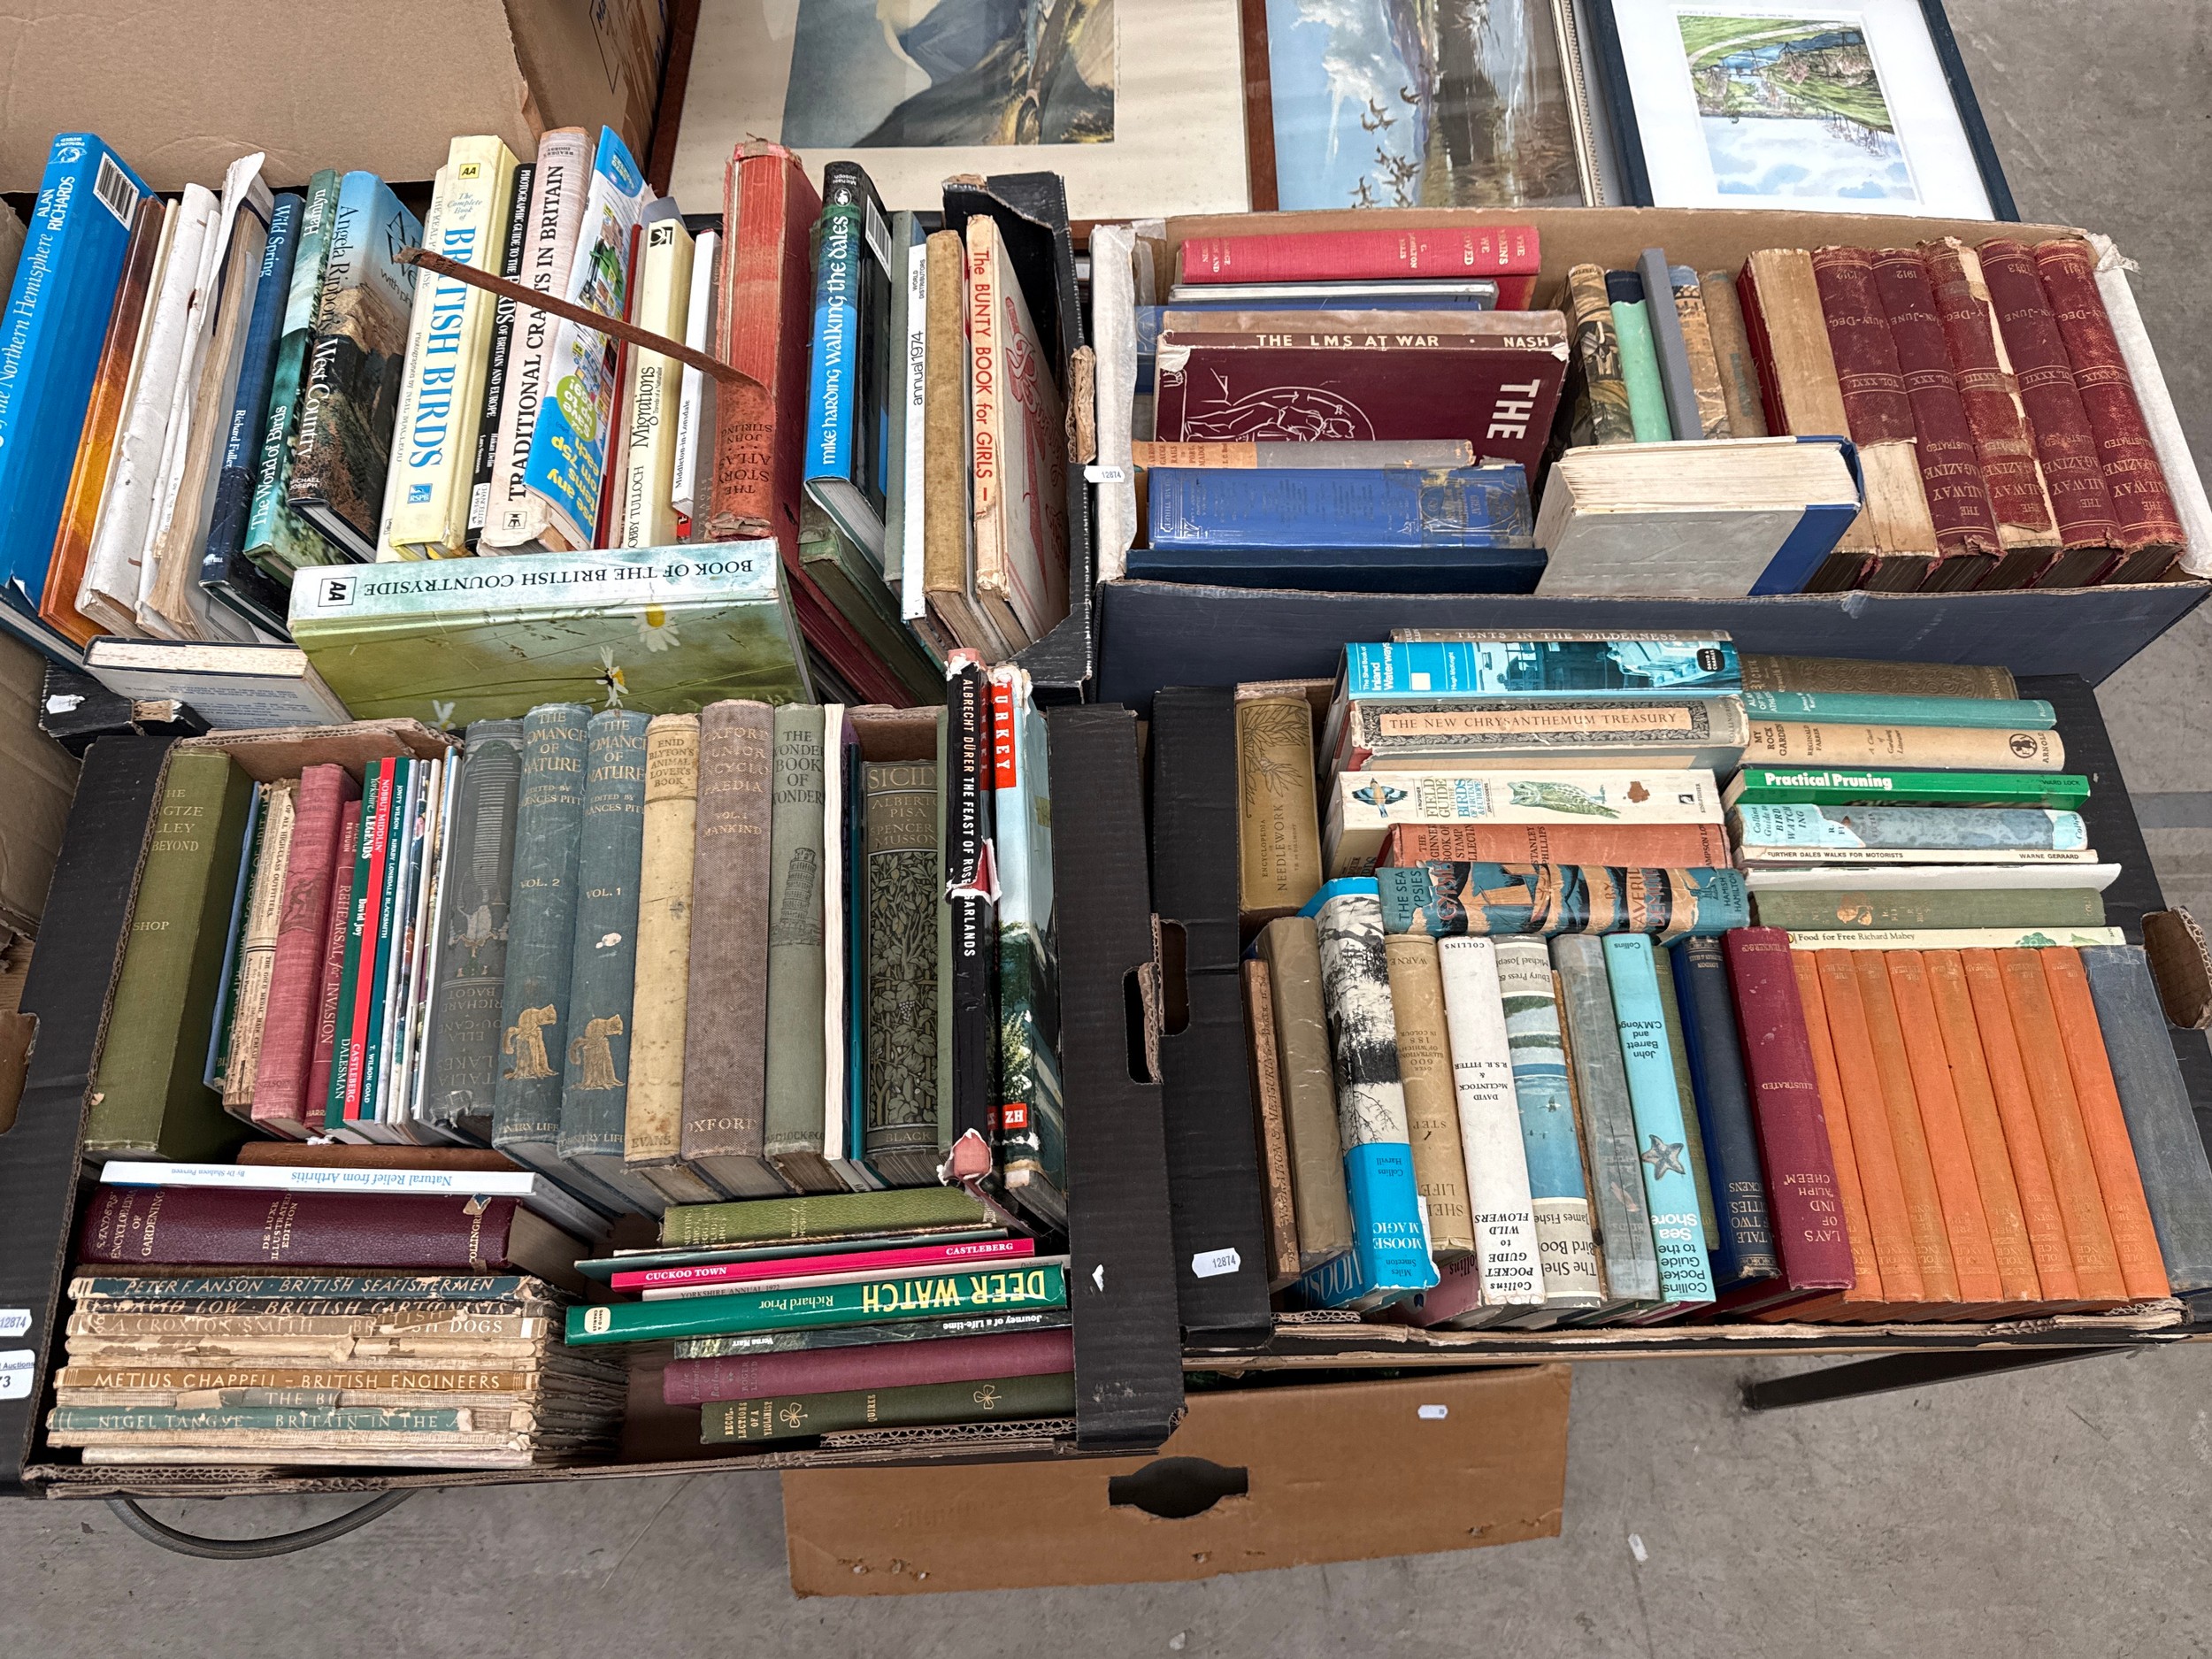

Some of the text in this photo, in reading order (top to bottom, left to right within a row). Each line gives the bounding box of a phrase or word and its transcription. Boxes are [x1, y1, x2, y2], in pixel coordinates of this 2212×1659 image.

[37, 188, 55, 218] ALAN
[48, 176, 75, 231] RICHARDS
[303, 188, 326, 237] Hamlyn
[259, 204, 291, 277] Wild Spring
[13, 233, 53, 319] Hemisphere
[318, 206, 358, 334] Angela Rippon's
[829, 260, 846, 296] the
[509, 166, 564, 501] TRADITIONAL CRATS IN BRITAIN
[1256, 334, 1549, 348] THE LMS AT WAR NASH
[1, 319, 30, 389] Northern
[973, 250, 992, 479] The BUNTY BOOK for GIRLS
[297, 338, 337, 458] West Country
[632, 366, 658, 448] Migrations
[1486, 379, 1540, 440] THE
[409, 365, 456, 467] BIRDS
[675, 399, 690, 488] Middleton-in-Lonsdale
[726, 434, 762, 443] JOHN
[251, 405, 287, 530] The World of Birds
[630, 465, 644, 515] TULLOCH
[410, 494, 430, 503] RSPB
[364, 560, 753, 595] BOOK OF THE BRITISH COUNTRYSIDE
[1581, 633, 1678, 641] WILDERNESS
[1382, 642, 1394, 691] Waterways
[1371, 662, 1381, 691] Inland
[963, 679, 974, 732] ALBRECHT
[538, 712, 566, 723] THE
[1389, 713, 1677, 729] THE NEW CHRYSANTHEMUM TREASURY
[657, 739, 685, 748] ENID
[783, 731, 812, 741] THE
[1755, 730, 1763, 744] MY
[1774, 724, 1787, 757] GARDEN
[963, 736, 976, 772] DÜRER
[651, 757, 690, 769] ANIMAL
[776, 758, 822, 772] BOOK
[654, 778, 684, 787] BOOK
[787, 774, 809, 787] OF
[963, 777, 974, 797] THE
[1764, 772, 1893, 791] Practical Pruning
[890, 808, 926, 818] PISA
[963, 802, 974, 836] FEAST
[963, 841, 974, 854] OF
[1273, 804, 1287, 891] NEEDLEWORK
[1395, 871, 1409, 921] THE SEA
[1720, 877, 1731, 907] HAMISH
[1728, 873, 1741, 912] HAMILTON
[1890, 933, 1915, 942] Mabey
[334, 1038, 350, 1099] DALESMAN
[1005, 1110, 1024, 1124] HZ
[632, 1133, 672, 1148] EVANS
[291, 1171, 452, 1186] Natural Relief from Arthritis
[1421, 1184, 1455, 1195] LIFE
[1810, 1201, 1835, 1211] IND
[142, 1191, 165, 1256] GARDENING
[282, 1202, 298, 1248] EDITION
[1474, 1212, 1529, 1223] FLOWERS
[1651, 1213, 1697, 1226] Shore
[1822, 1216, 1838, 1225] OF
[1373, 1222, 1420, 1233] MAGIC
[1659, 1228, 1692, 1240] Sea
[1804, 1230, 1841, 1241] LAYS
[1373, 1238, 1423, 1249] MOOSE
[646, 1242, 1014, 1281] CUCKOO TOWN CASTLEBERG
[1212, 1255, 1236, 1269] 12874
[1488, 1252, 1527, 1263] GUIDE
[1661, 1256, 1700, 1267] Guide
[1485, 1267, 1534, 1278] POCKET
[1660, 1270, 1705, 1280] Pocket
[125, 1280, 177, 1293] PETER
[196, 1279, 263, 1293] ANSON
[279, 1279, 355, 1292] BRITISH
[361, 1279, 495, 1292] SEAFISHERMEN
[862, 1270, 1045, 1313] DEER WATCH
[1490, 1281, 1532, 1291] Collins
[1663, 1282, 1708, 1293] Collins
[759, 1295, 833, 1310] Richard Prior
[0, 1317, 27, 1327] 12874
[449, 1320, 502, 1333] DOGS
[94, 1374, 171, 1387] METIUS
[301, 1375, 378, 1388] BRITISH
[391, 1375, 500, 1388] ENGINEERS
[266, 1392, 303, 1405] THE
[98, 1416, 438, 1428] NIGEL TANGYE BRITAIN IN THE
